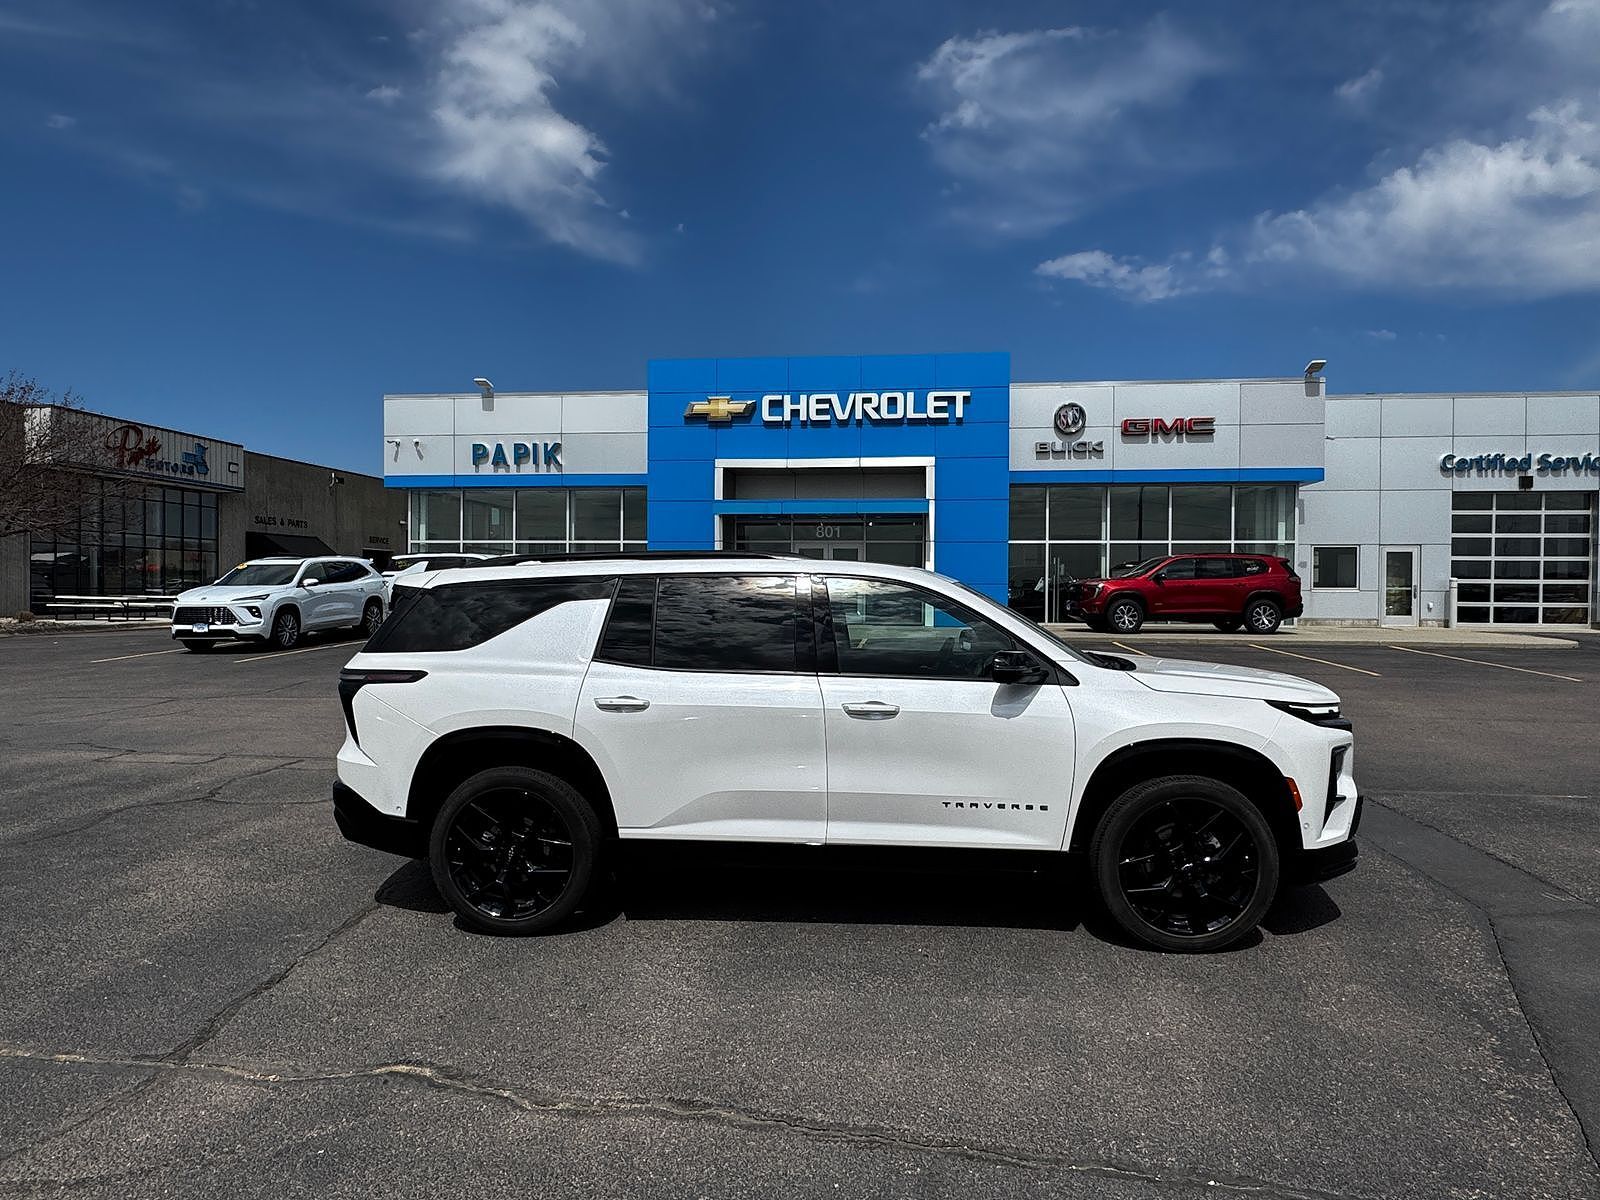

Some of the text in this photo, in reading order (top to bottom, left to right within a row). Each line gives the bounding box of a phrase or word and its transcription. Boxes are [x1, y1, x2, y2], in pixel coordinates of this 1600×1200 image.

[761, 390, 971, 422] CHEVROLET
[1121, 416, 1216, 437] GMC
[1035, 440, 1104, 454] BUICK
[471, 442, 563, 467] PAPIK
[1440, 452, 1533, 472] Certified
[254, 515, 308, 529] SALES & PARTS
[815, 525, 841, 538] 801
[368, 535, 390, 545] SERVICE
[941, 801, 1049, 811] TRAVERSE
